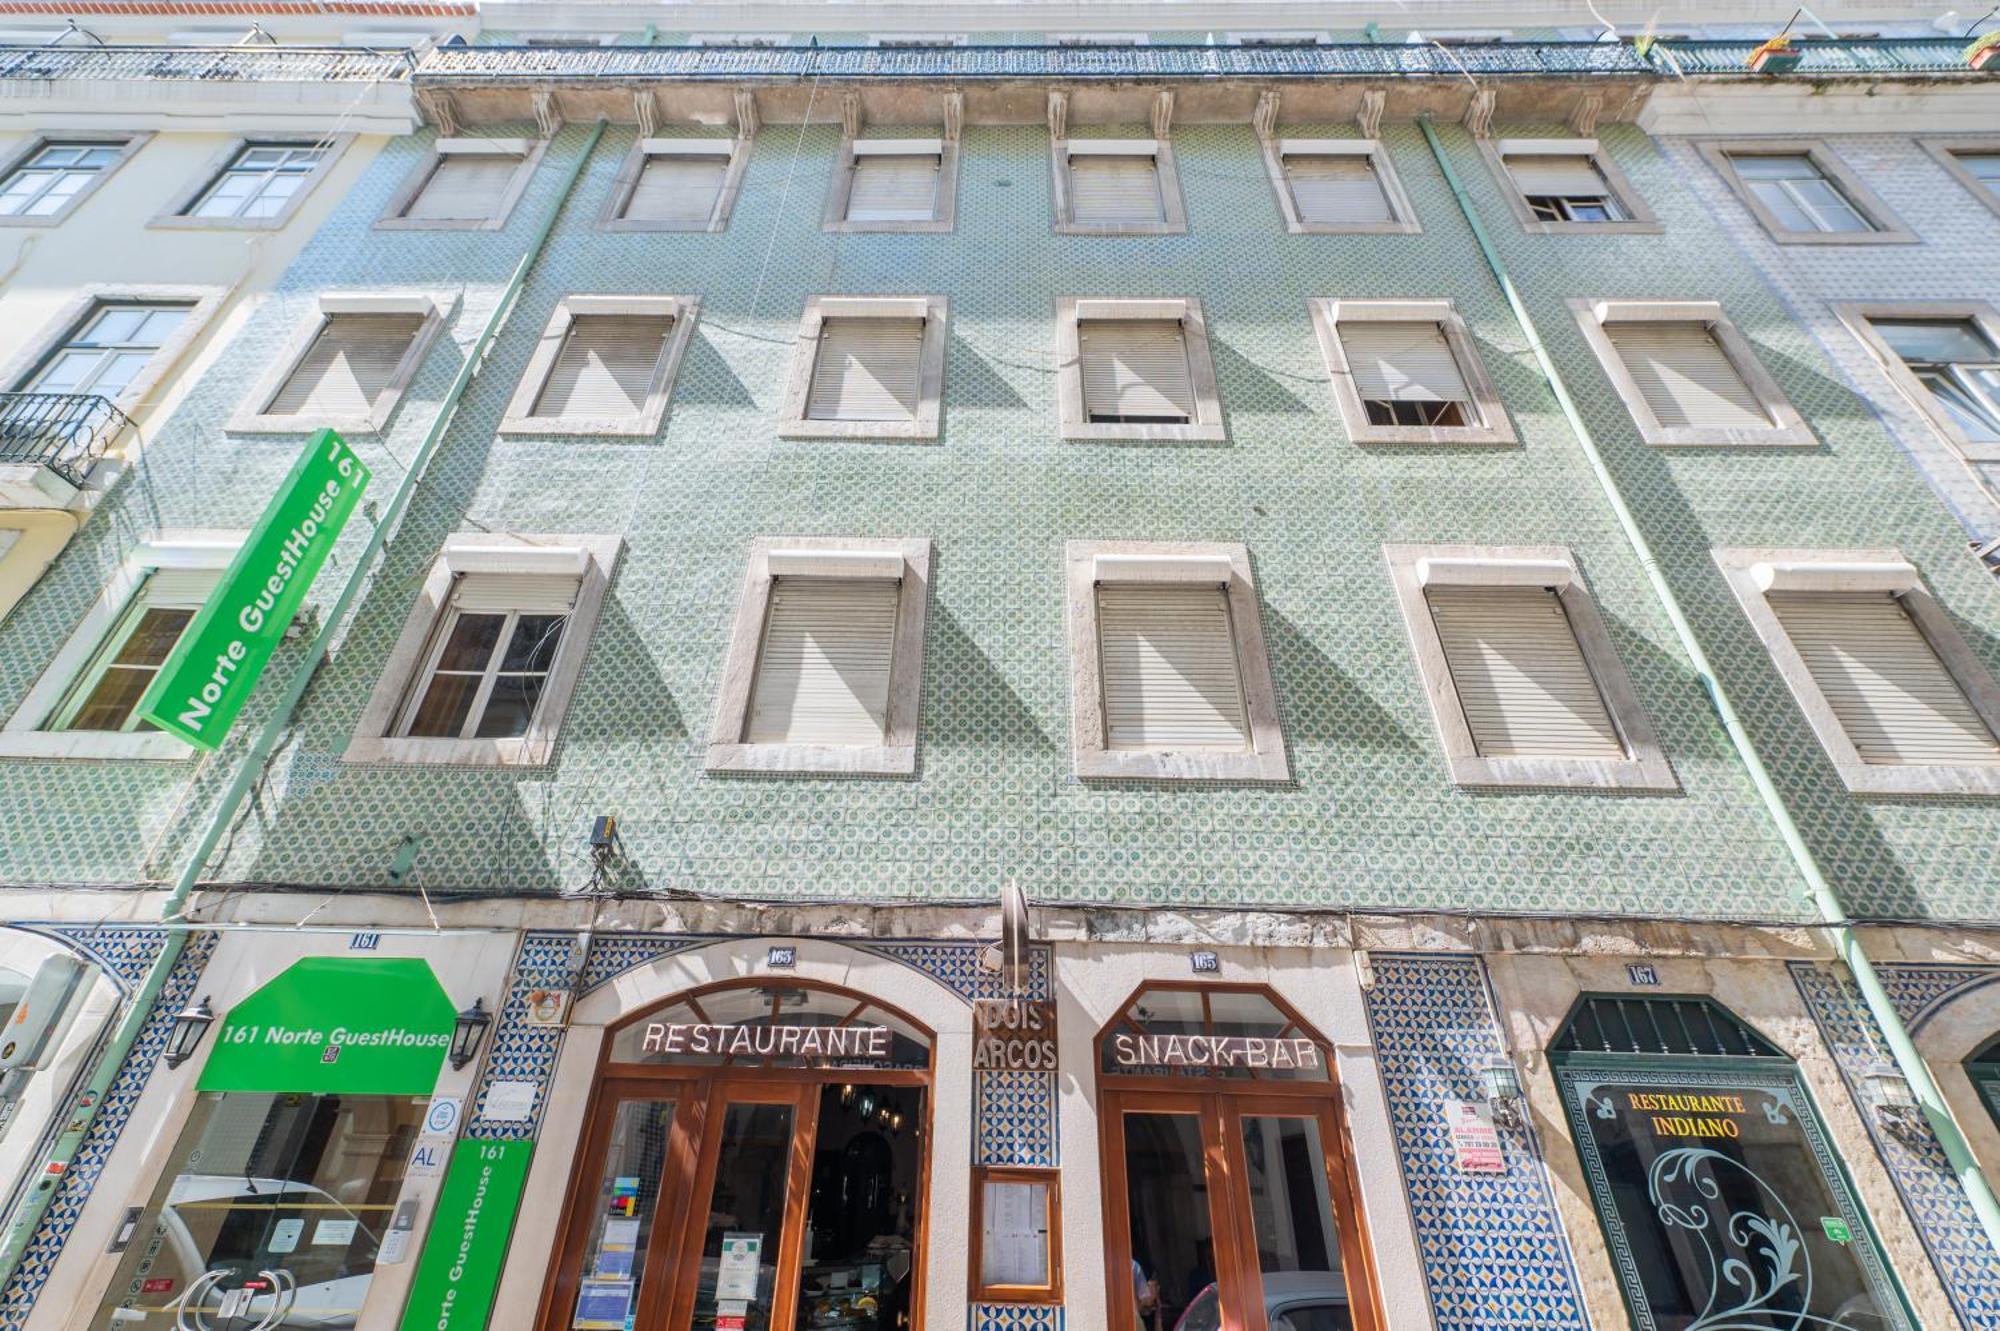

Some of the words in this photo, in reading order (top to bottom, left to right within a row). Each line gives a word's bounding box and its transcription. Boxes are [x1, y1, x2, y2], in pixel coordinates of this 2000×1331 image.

[327, 441, 365, 489] 161
[178, 639, 247, 731] Norte
[239, 478, 341, 633] GuestHouse
[354, 933, 378, 948] 161
[1194, 954, 1217, 969] 165
[1629, 966, 1655, 984] 167
[986, 1001, 1043, 1030] DOIS
[222, 1025, 259, 1044] 161
[265, 1026, 323, 1045] Norte
[329, 1027, 450, 1048] GuestHouse
[642, 1023, 888, 1055] RESTAURANTE
[973, 1038, 1057, 1069] ARCOS
[1628, 1092, 1746, 1113] RESTAURANTE
[1651, 1116, 1739, 1138] INDIANO
[411, 1147, 436, 1166] AL
[479, 1145, 505, 1160] 161
[437, 1289, 456, 1331] orte
[449, 1165, 492, 1281] GuestHouse
